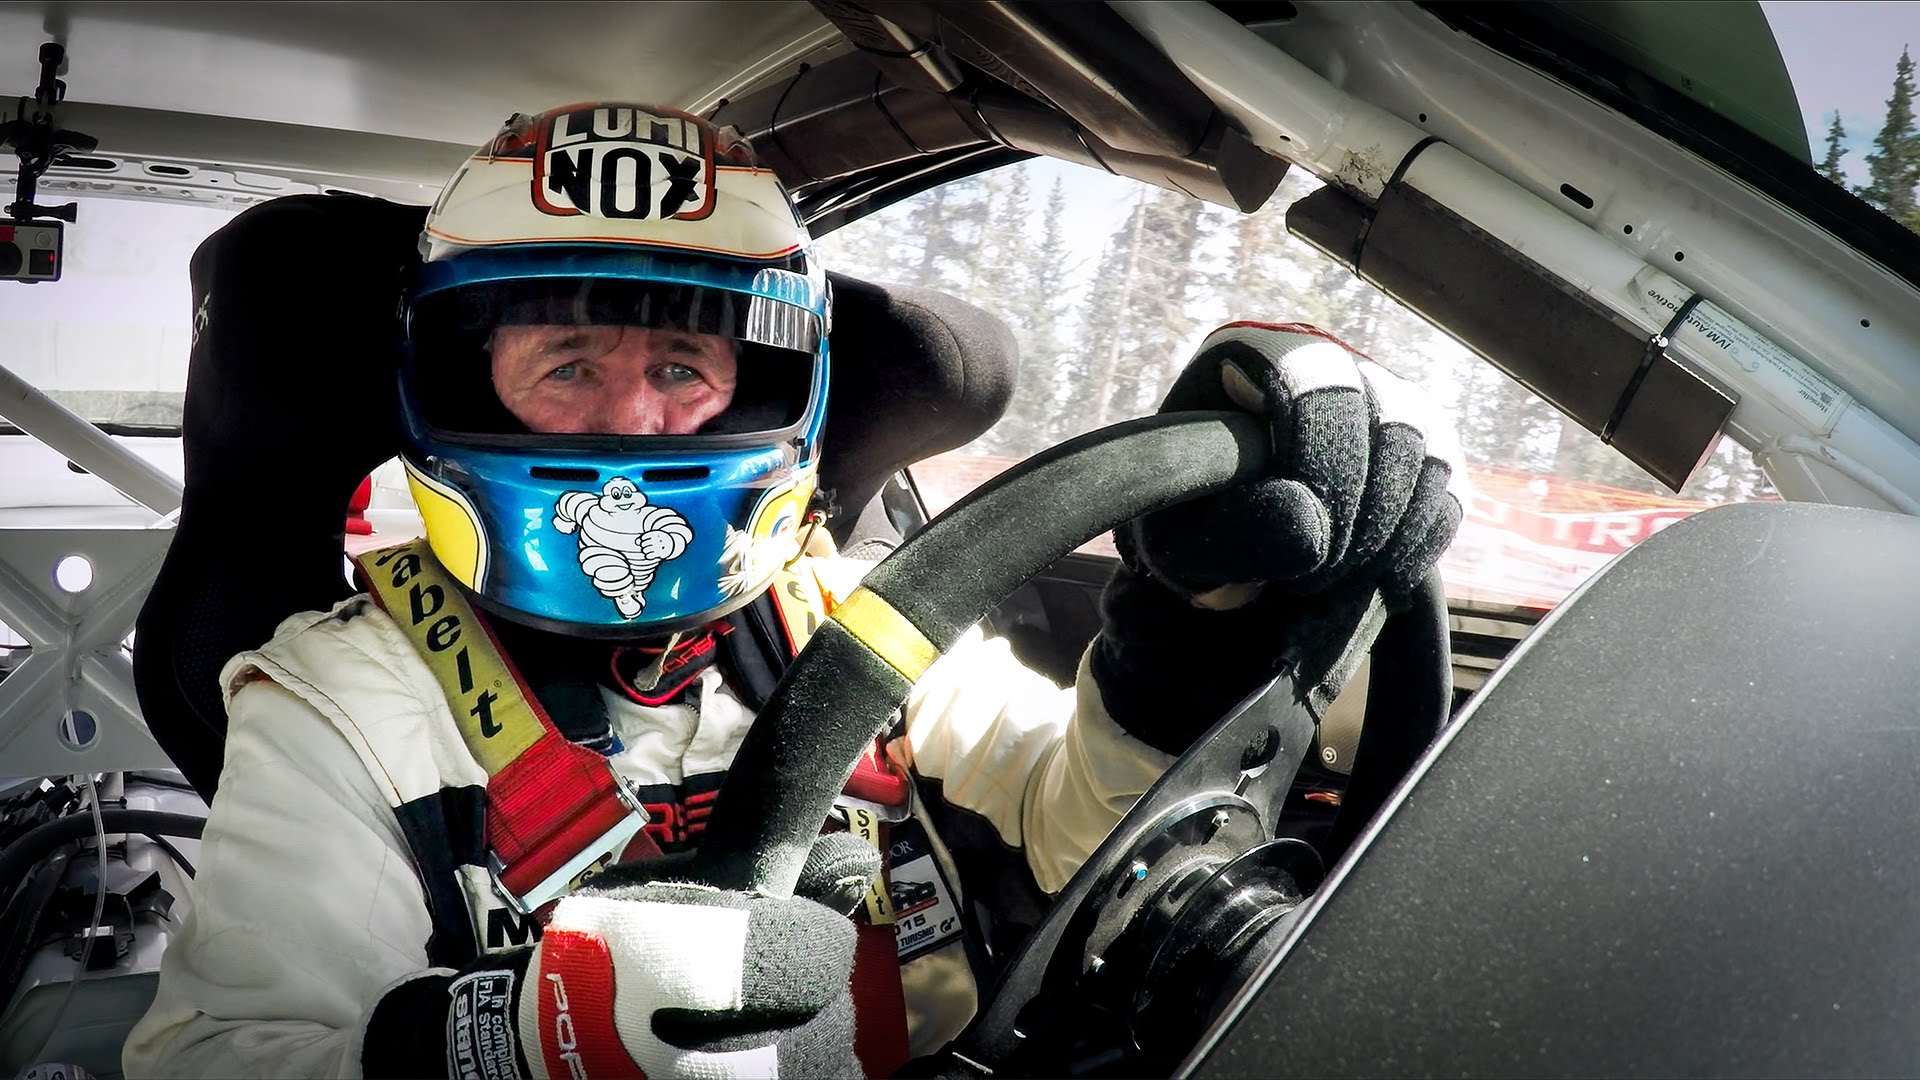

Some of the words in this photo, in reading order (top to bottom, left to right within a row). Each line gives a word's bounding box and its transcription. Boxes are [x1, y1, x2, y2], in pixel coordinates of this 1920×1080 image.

[551, 108, 700, 154] LUMI
[548, 148, 701, 220] NOX
[1647, 288, 1708, 334] Autotive
[1705, 330, 1731, 350] IVM
[1797, 389, 1829, 413] Hersteller
[889, 840, 914, 859] OR
[477, 980, 493, 1008] FIA
[491, 995, 508, 1008] In
